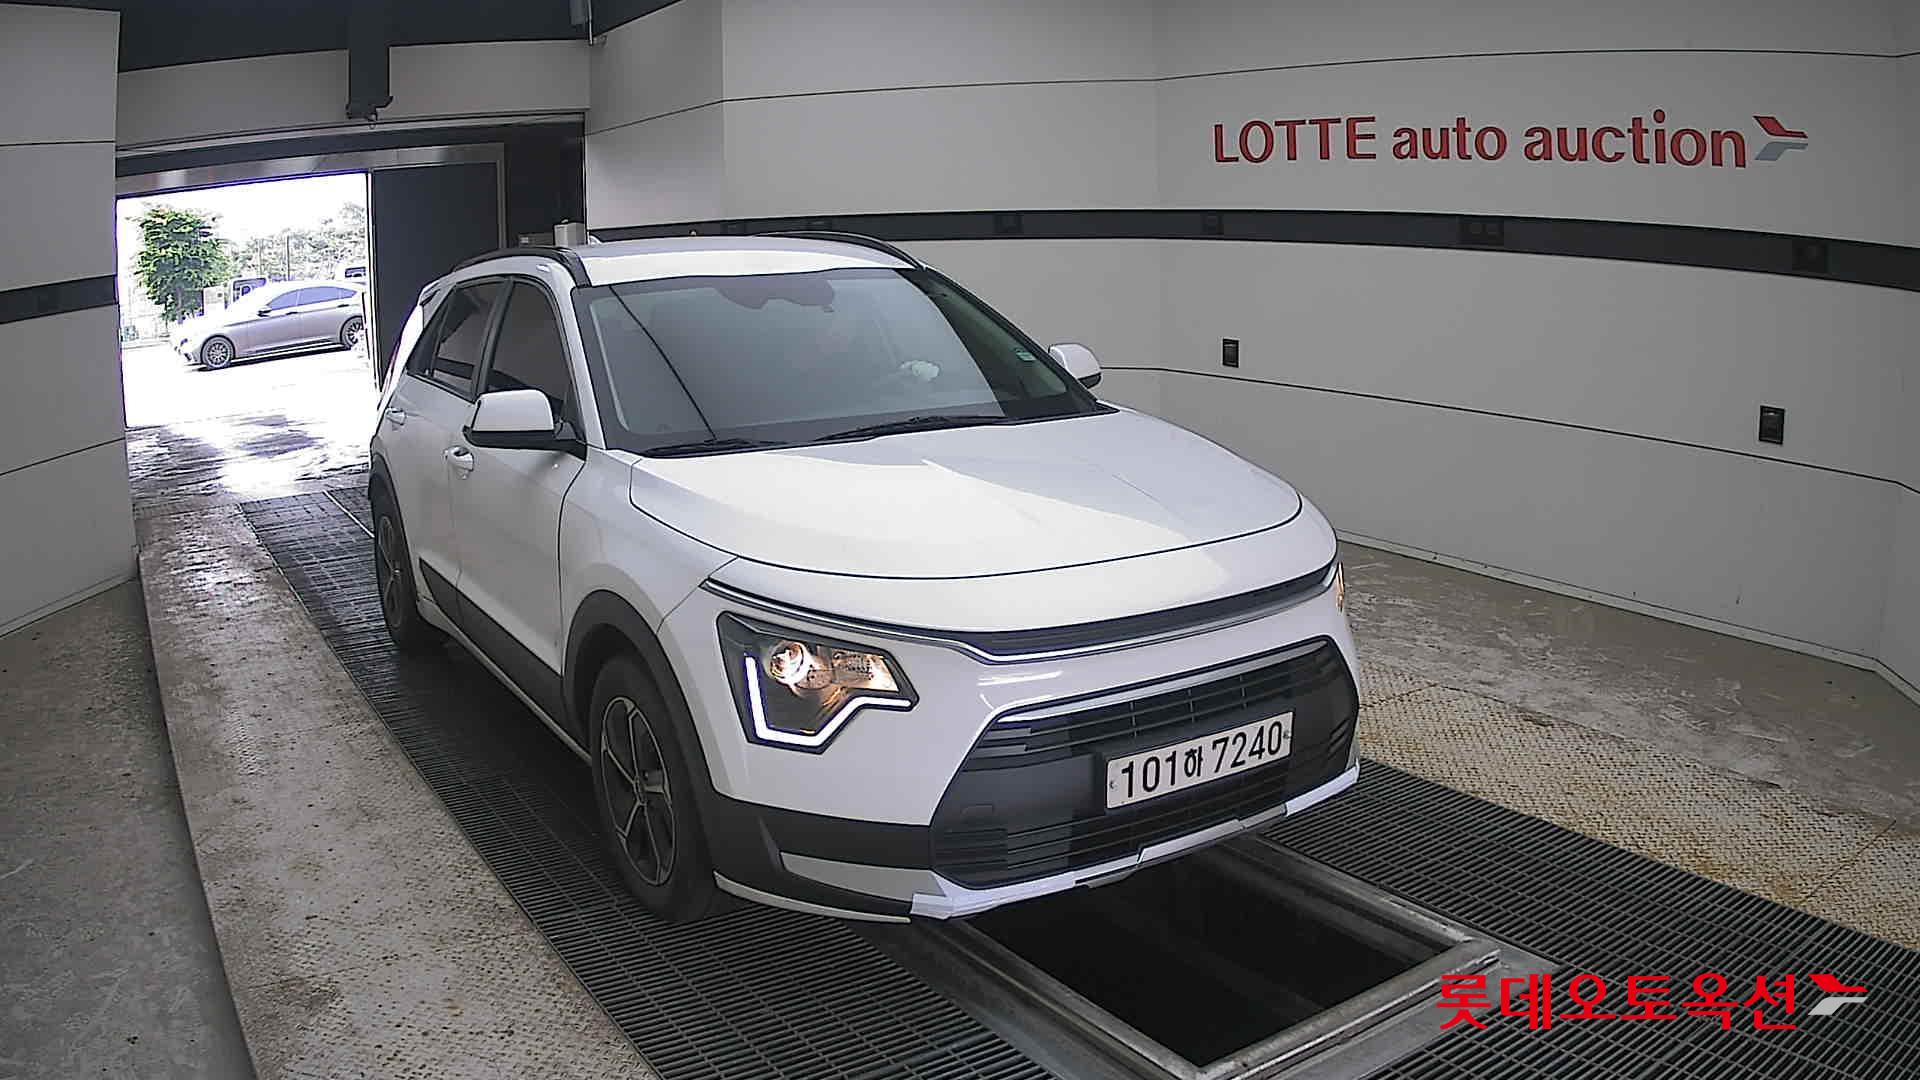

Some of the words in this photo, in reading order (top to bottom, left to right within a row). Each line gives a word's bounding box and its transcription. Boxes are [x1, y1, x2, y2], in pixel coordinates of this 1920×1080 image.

[1213, 115, 1377, 164] LOTTE
[1392, 116, 1507, 162] auto
[1523, 110, 1748, 168] auction
[1121, 746, 1204, 798] 101하
[1212, 721, 1283, 773] 7240
